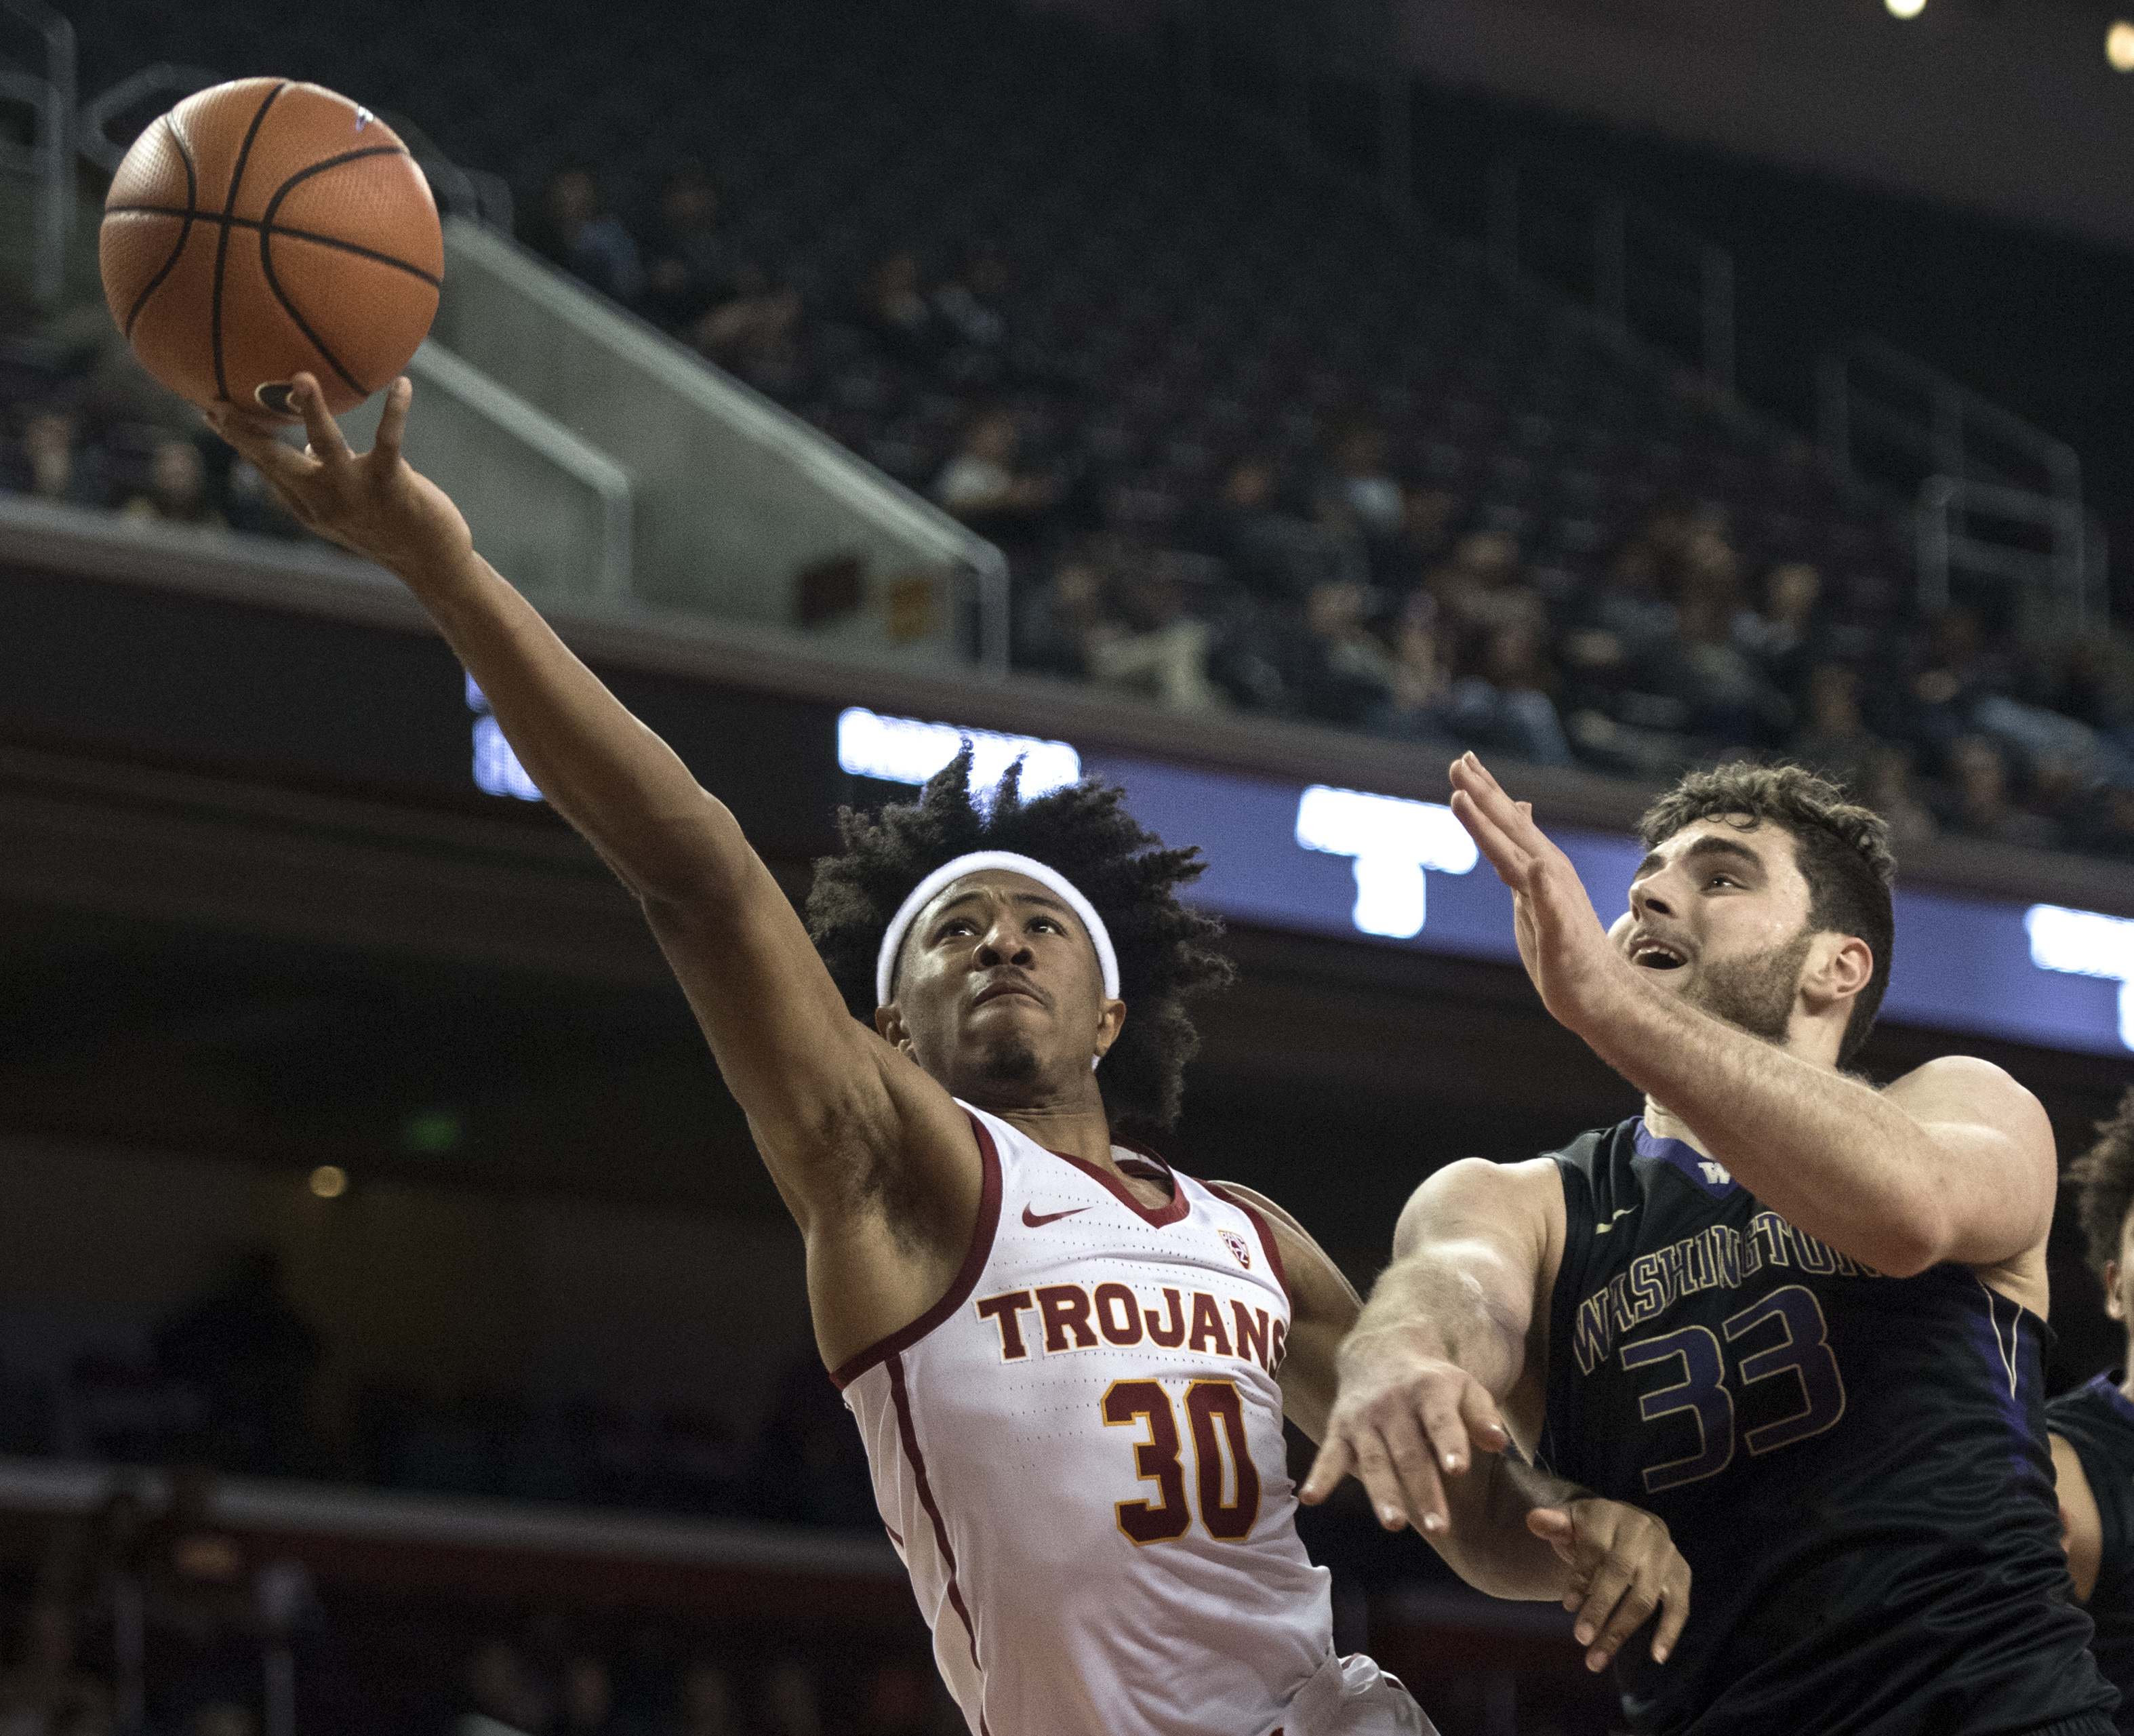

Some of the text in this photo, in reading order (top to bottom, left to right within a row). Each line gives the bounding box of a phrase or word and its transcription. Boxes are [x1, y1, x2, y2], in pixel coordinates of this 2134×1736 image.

[975, 1282, 1287, 1381] TROJANS
[1619, 1285, 1846, 1493] 33
[1101, 1378, 1260, 1547] 30
